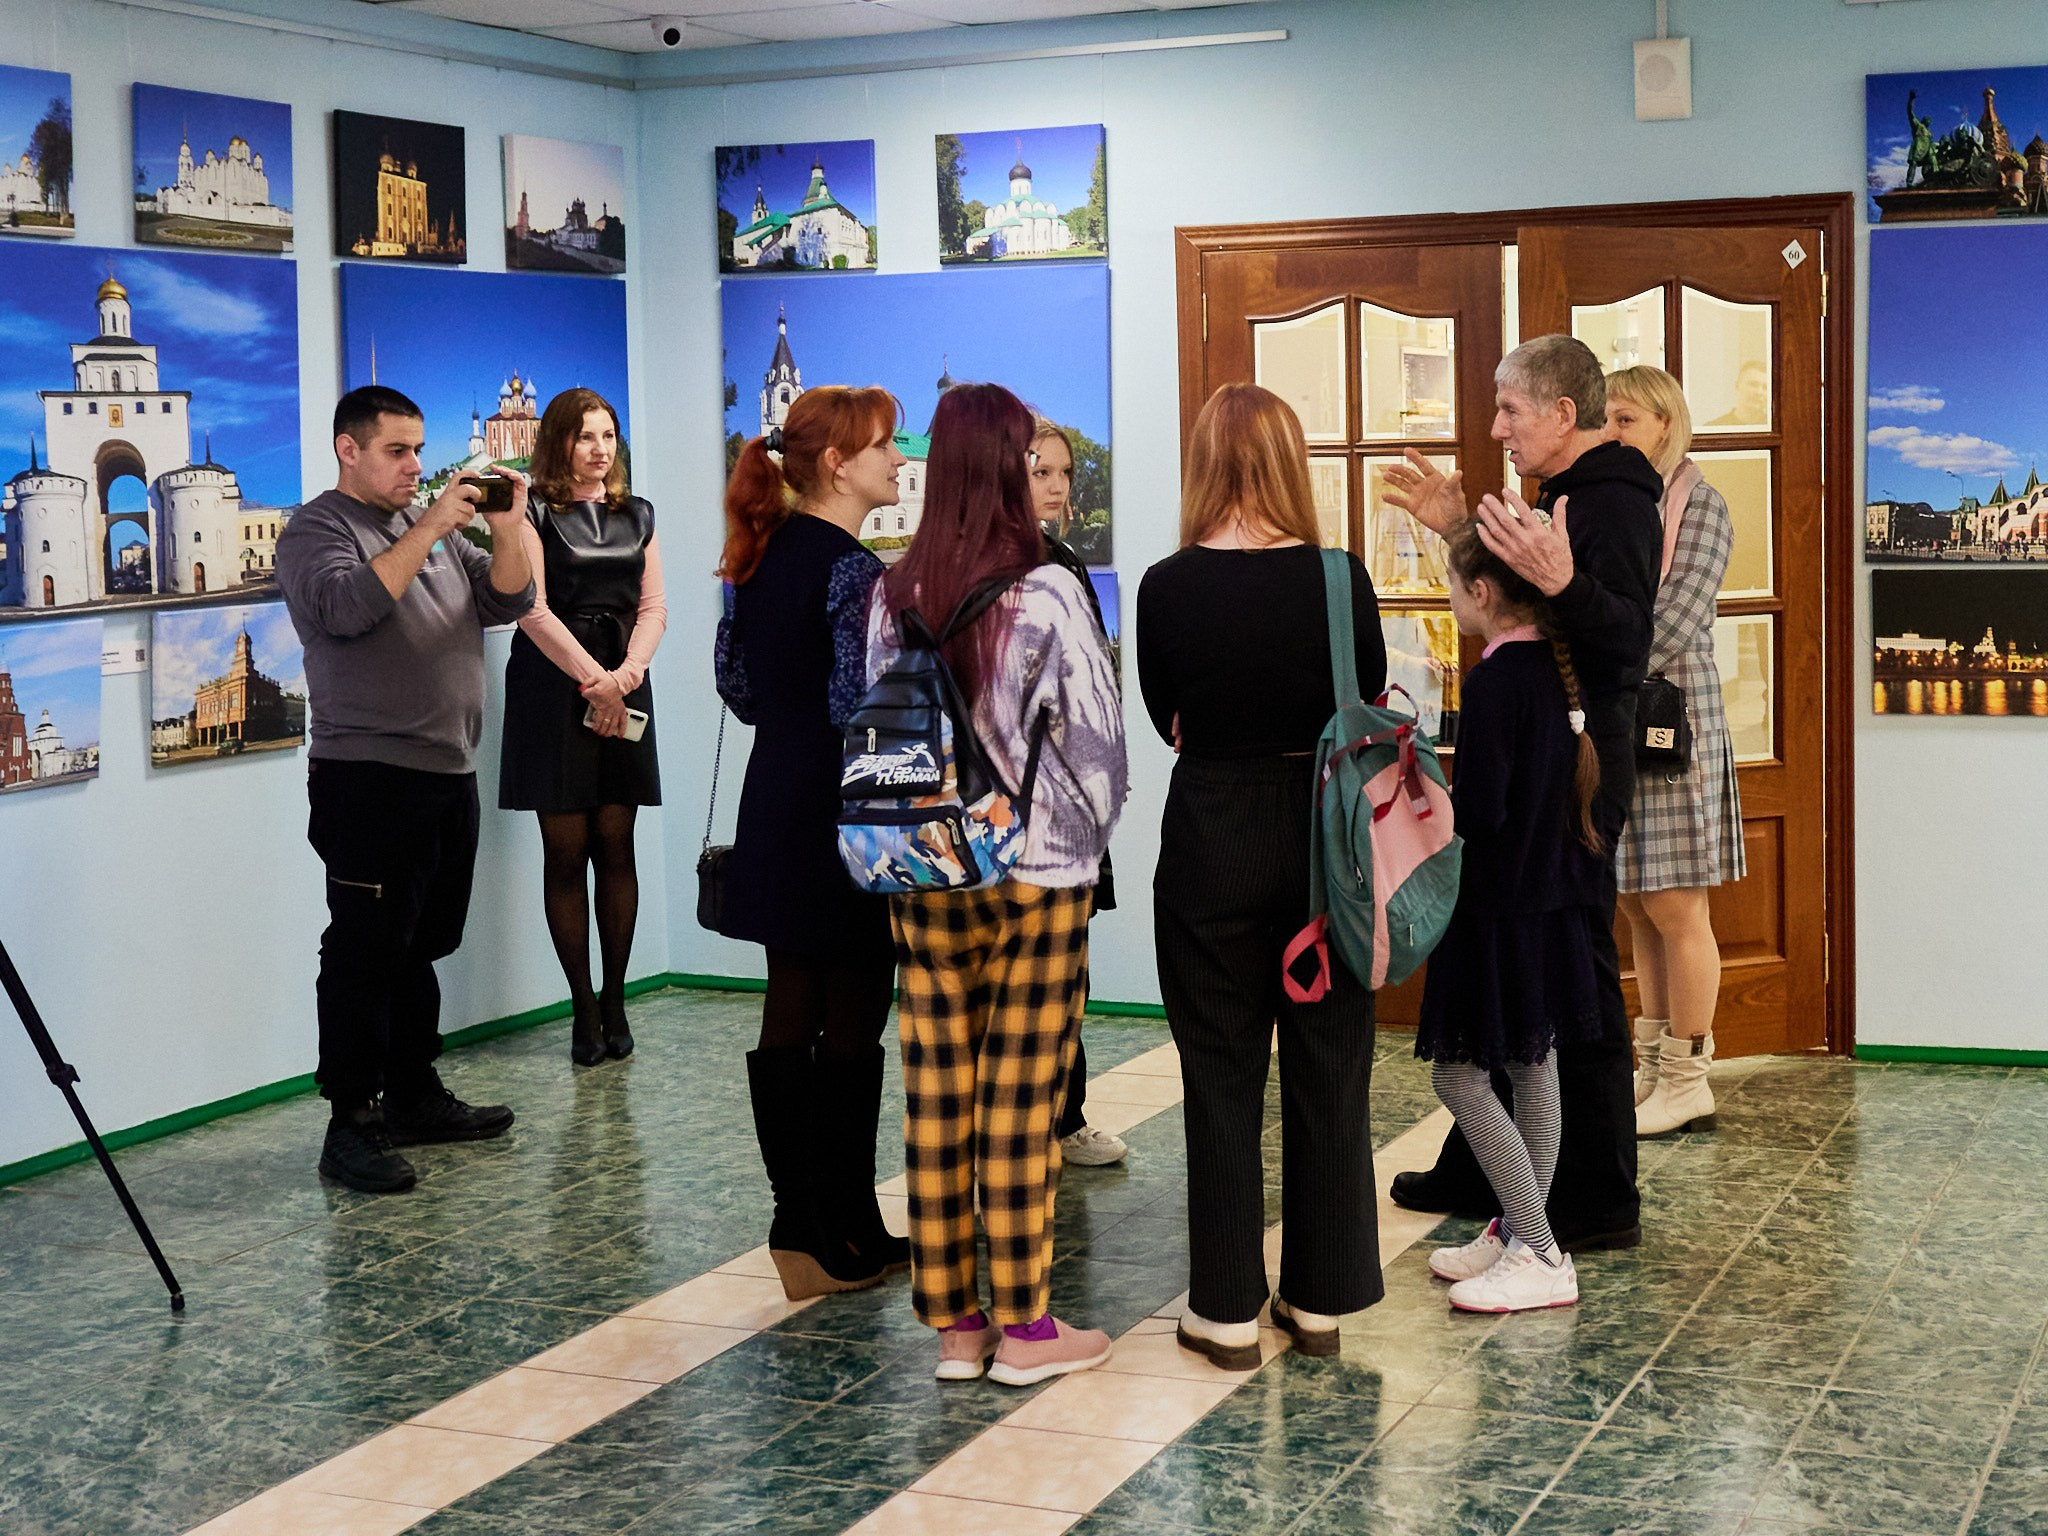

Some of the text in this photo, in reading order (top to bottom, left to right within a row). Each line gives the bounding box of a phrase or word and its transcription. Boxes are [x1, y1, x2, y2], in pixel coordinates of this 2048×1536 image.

[1788, 250, 1800, 260] 60
[1654, 731, 1666, 745] S
[909, 770, 940, 783] MAN
